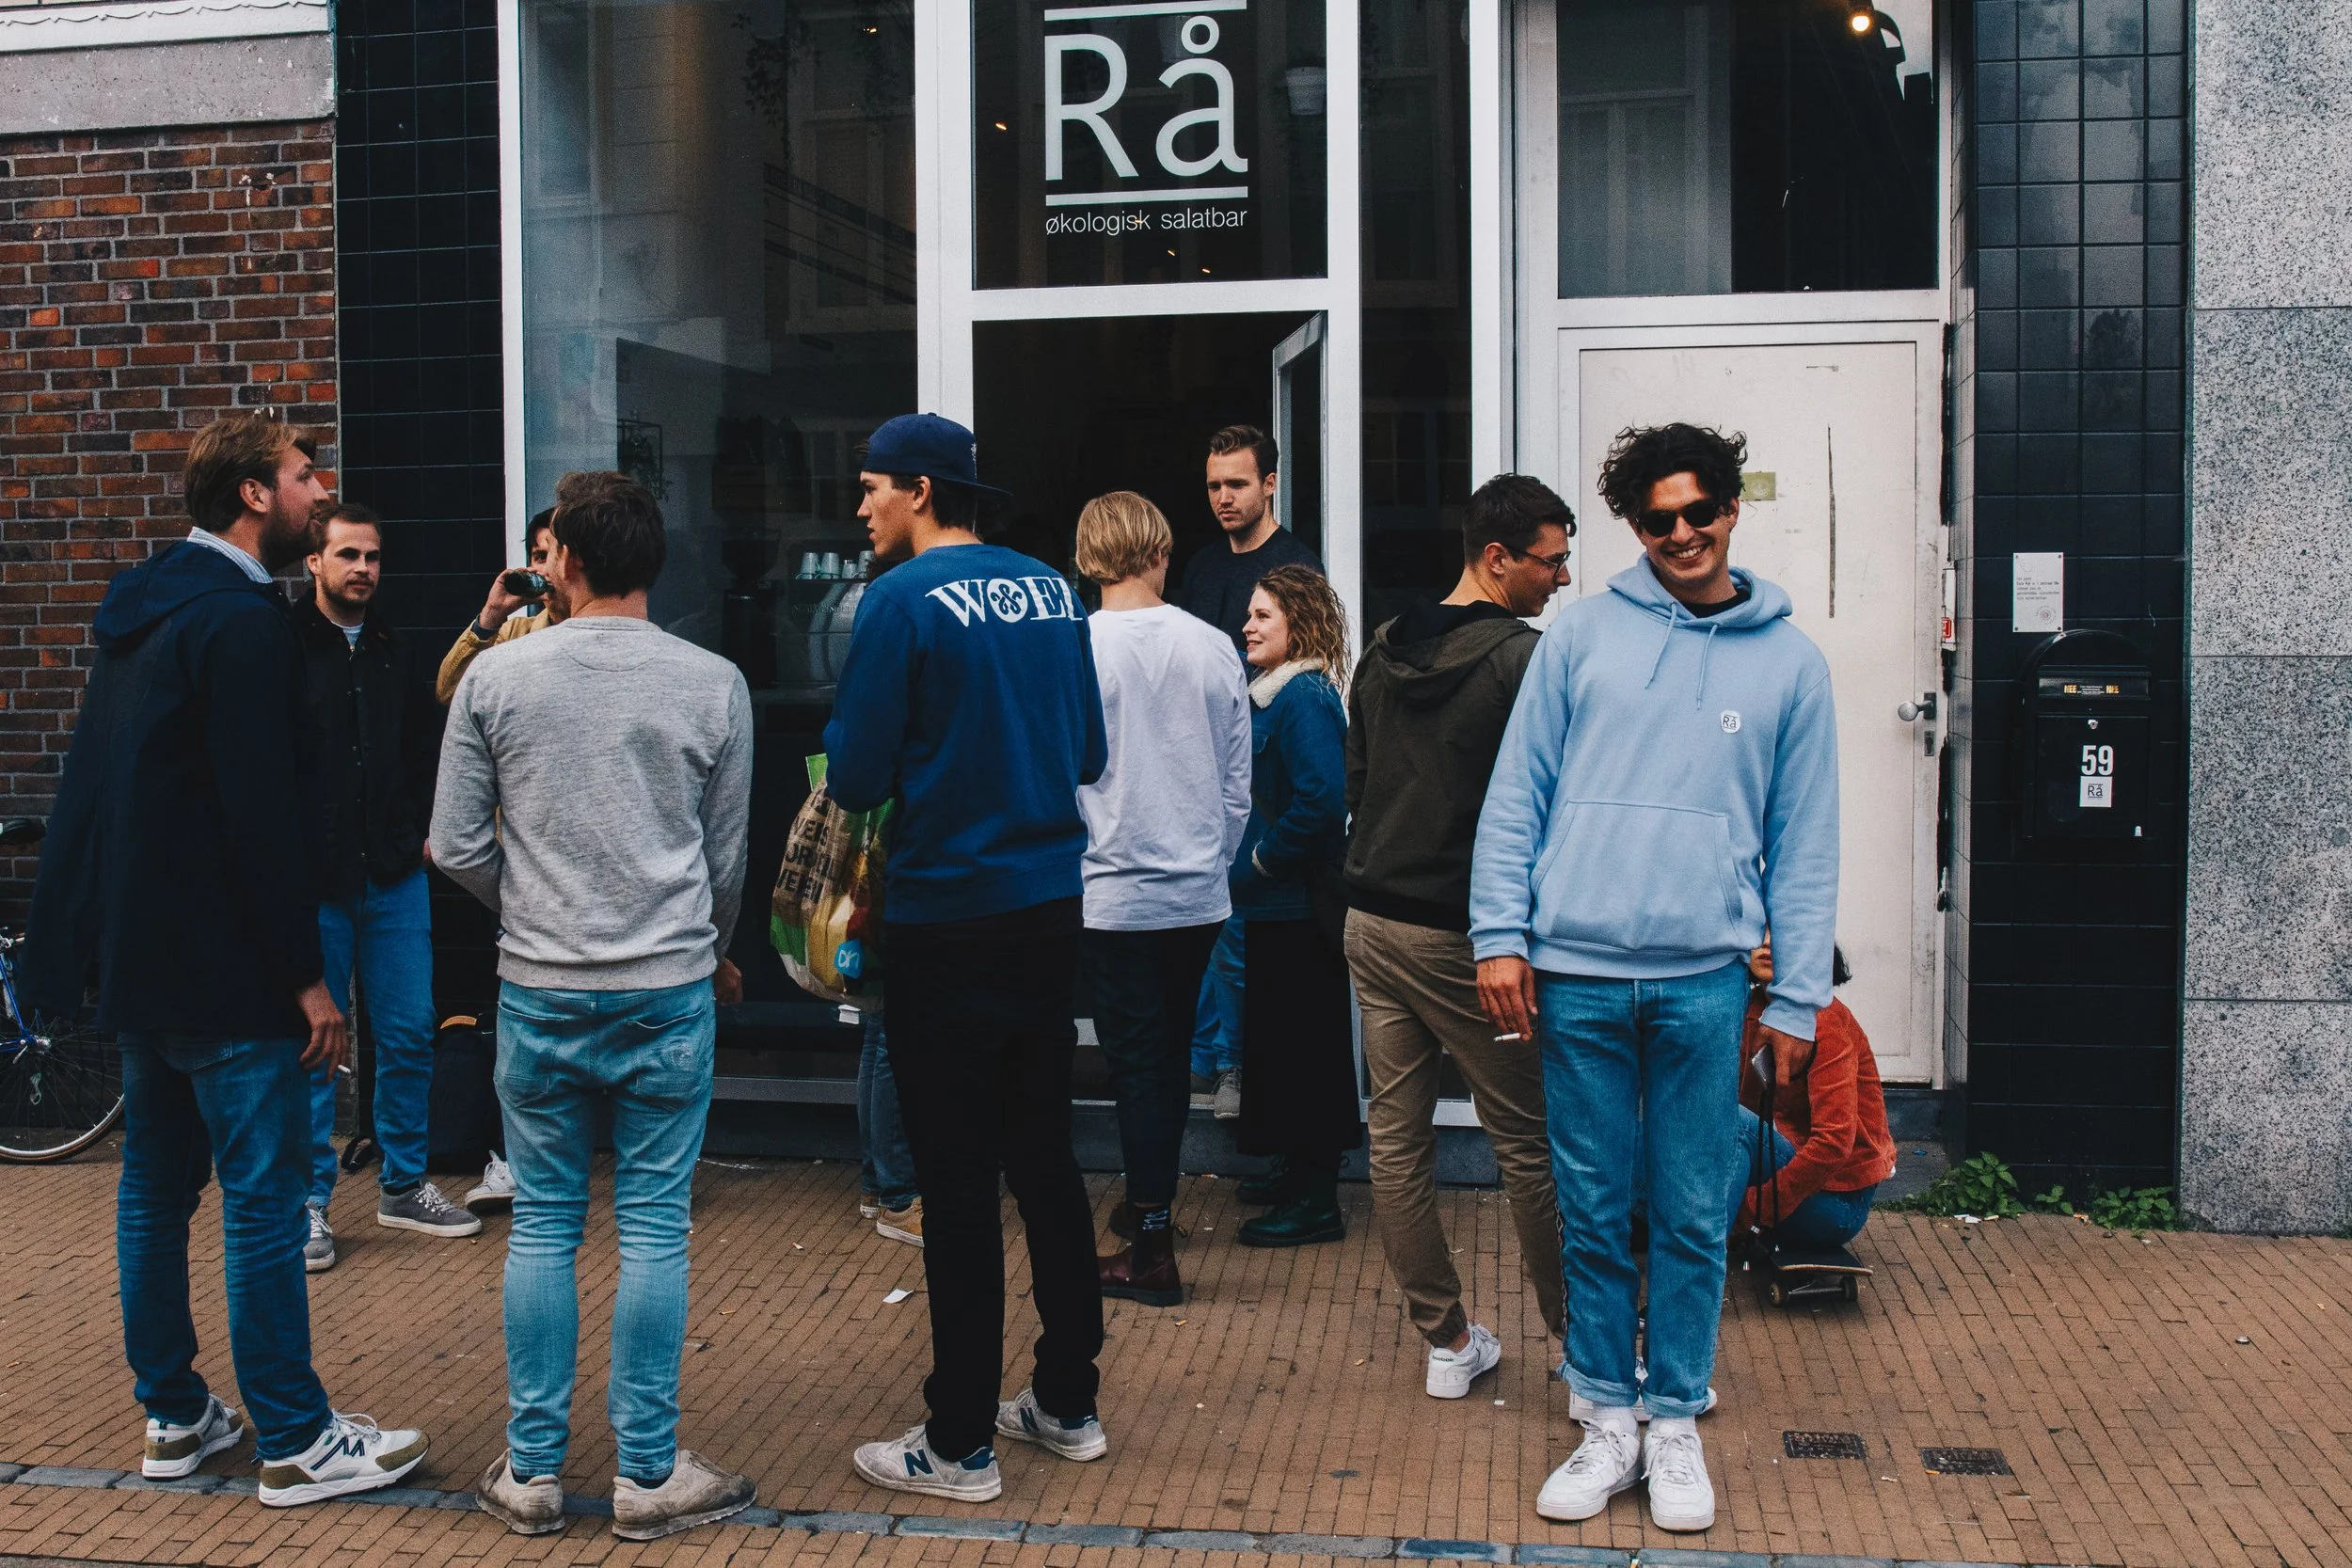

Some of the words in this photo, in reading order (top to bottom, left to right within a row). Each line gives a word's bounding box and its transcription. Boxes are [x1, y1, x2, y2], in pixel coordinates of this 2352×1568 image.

[1044, 15, 1248, 181] Rå
[1045, 209, 1152, 236] økologisk
[1160, 206, 1248, 230] salatbar
[2081, 744, 2114, 776] 59
[2088, 784, 2104, 797] Rå
[903, 1449, 934, 1477] N
